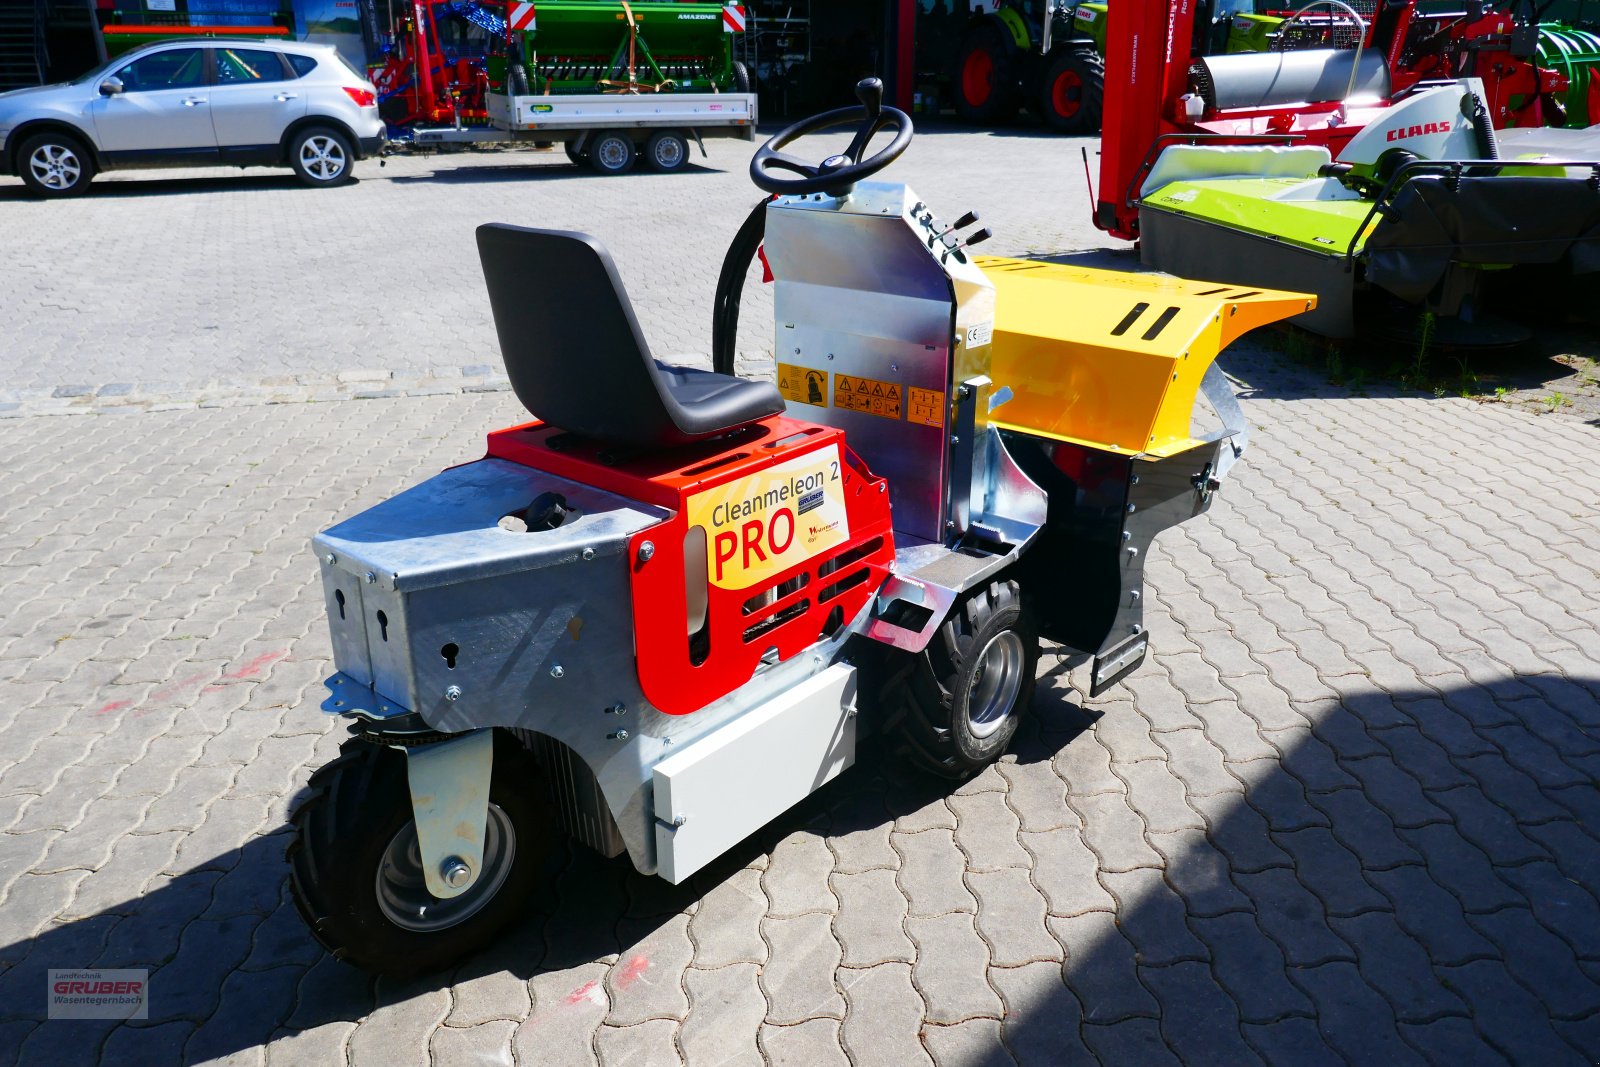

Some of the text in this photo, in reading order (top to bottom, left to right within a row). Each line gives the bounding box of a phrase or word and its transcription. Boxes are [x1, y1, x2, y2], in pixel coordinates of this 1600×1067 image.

[1386, 121, 1451, 142] CLAAS
[712, 461, 839, 528] Cleanmeleon 2
[798, 490, 824, 506] GRUBER
[714, 507, 795, 582] PRO
